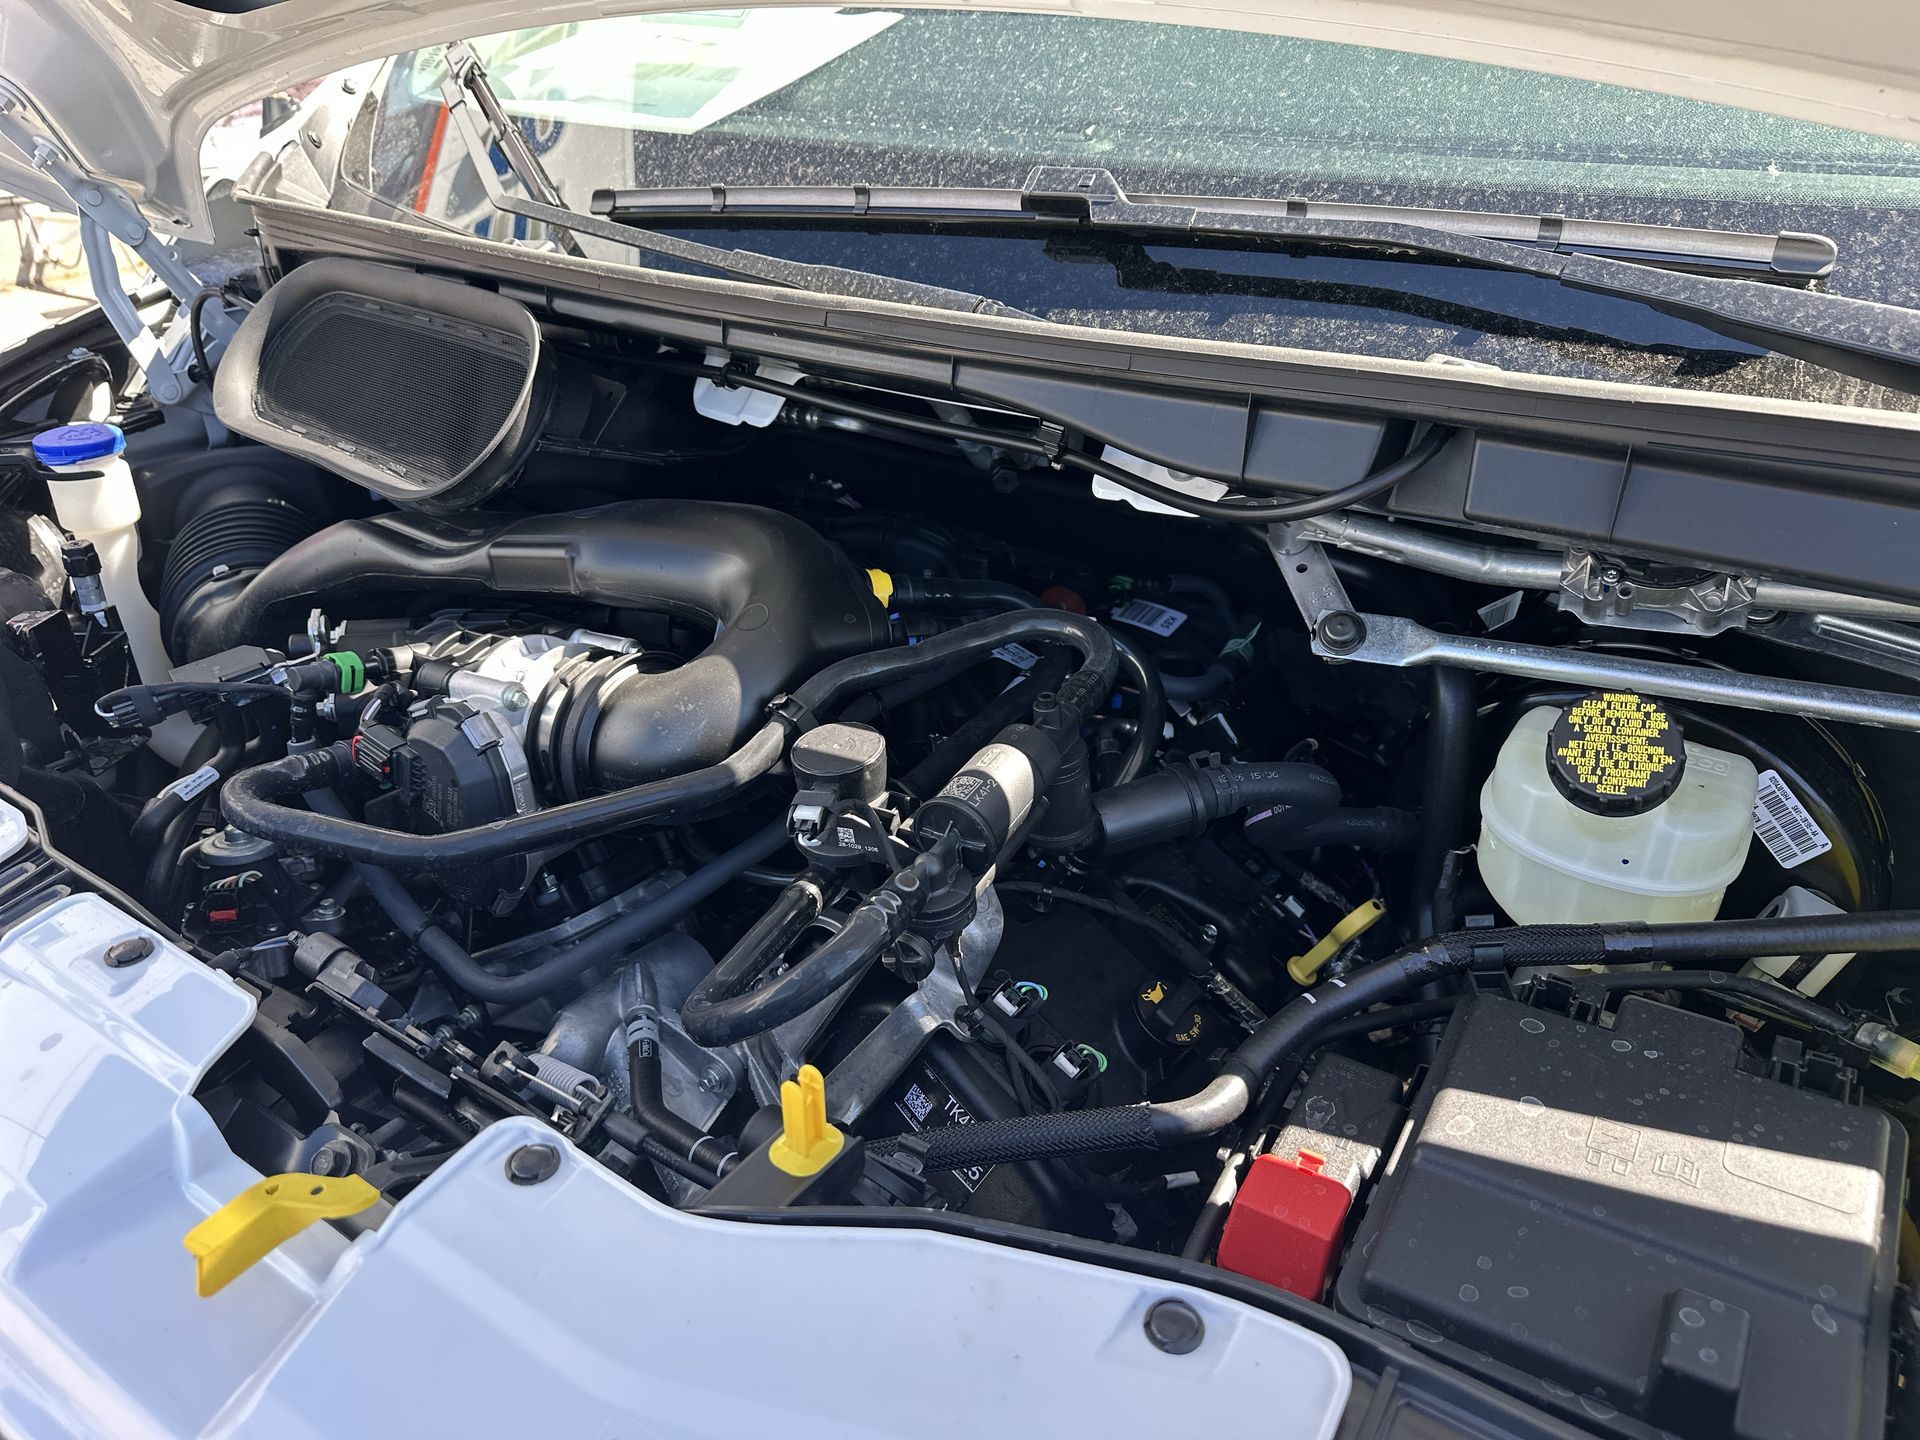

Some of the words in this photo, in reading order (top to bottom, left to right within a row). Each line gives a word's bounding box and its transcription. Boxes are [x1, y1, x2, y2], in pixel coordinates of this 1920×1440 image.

[1603, 693, 1640, 703] WARNING:
[1583, 700, 1607, 709] CLEAN
[1611, 702, 1637, 711] FILLER
[1641, 704, 1656, 712] CAP
[1572, 708, 1600, 717] BEFORE
[1605, 710, 1646, 720] REMOVING.
[1651, 713, 1666, 721] USE
[1569, 716, 1587, 724] ONLY
[1592, 717, 1607, 725] DOT
[1620, 720, 1642, 728] FLUID
[1646, 721, 1668, 730] FROM
[1574, 724, 1580, 732] A
[1584, 725, 1612, 733] SEALED
[1616, 727, 1660, 738] CONTAINER.
[1585, 734, 1648, 745] AVERTISSEMENT:
[1569, 741, 1607, 751] NETTOYER
[1612, 743, 1621, 751] LE
[1628, 745, 1664, 755] BOUCHON
[1557, 748, 1582, 757] AVANT
[1586, 750, 1596, 758] DE
[1653, 755, 1676, 765] N'EM-
[1567, 757, 1595, 766] PLOYER
[1599, 759, 1615, 768] QUE
[1619, 761, 1629, 769] DU
[1634, 762, 1664, 772] LIQUIDE
[1578, 766, 1592, 774] DOT
[1606, 768, 1651, 779] PROVENANT
[1580, 774, 1598, 783] D'UN
[1602, 776, 1647, 788] CONTENANT
[968, 778, 998, 808] LK41-2
[1175, 1033, 1191, 1042] SAE
[1189, 1014, 1202, 1038] 5W-30
